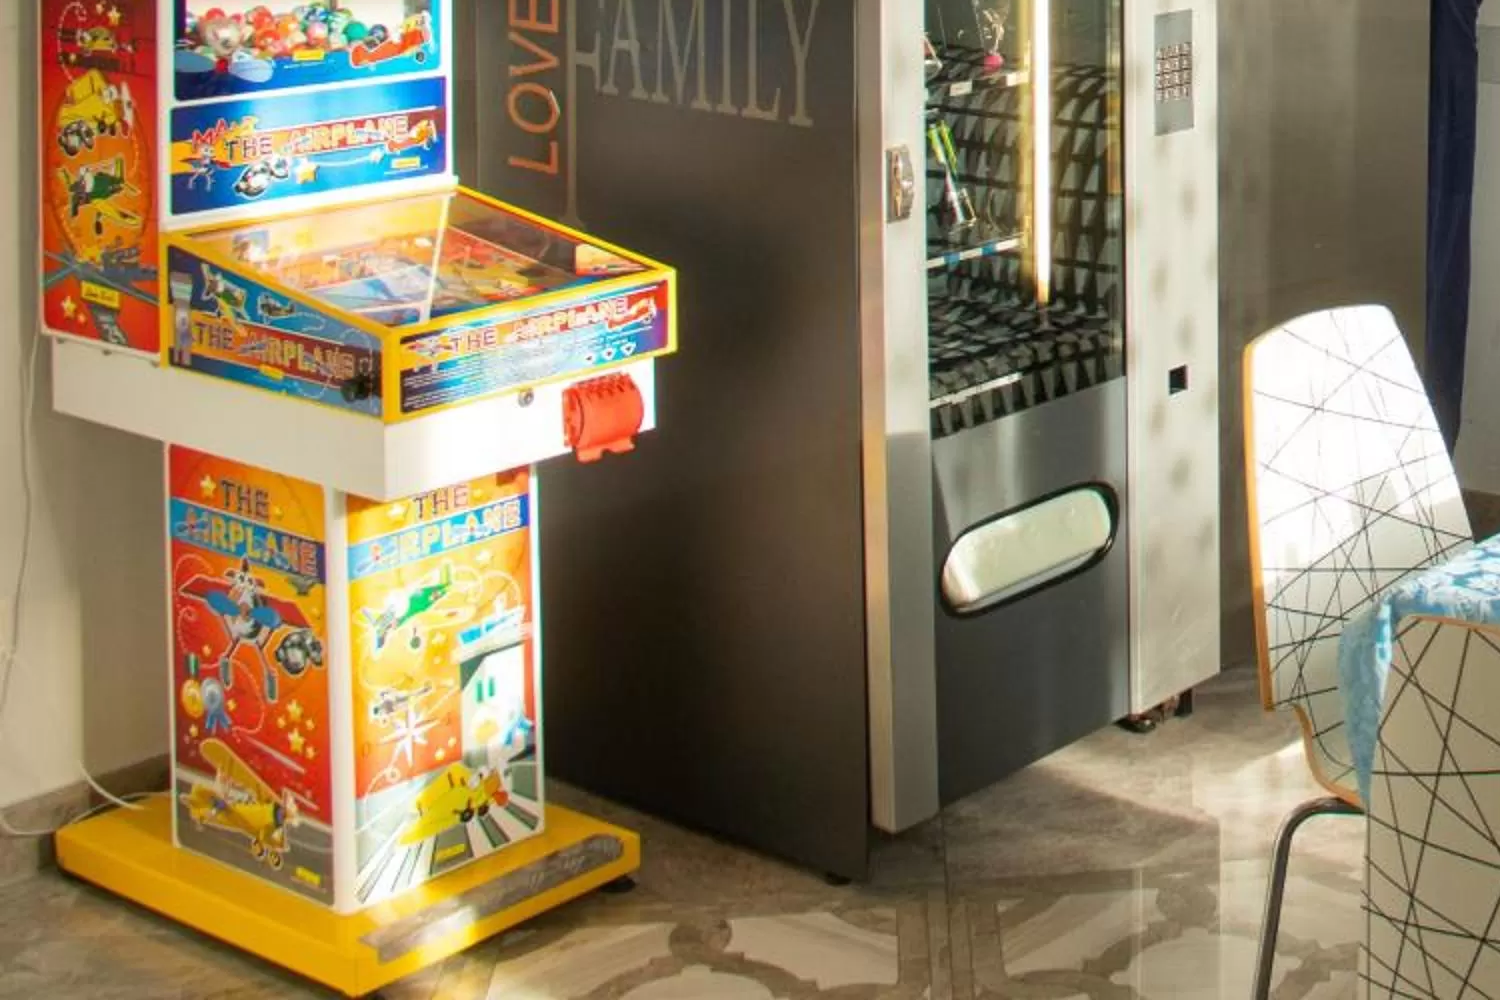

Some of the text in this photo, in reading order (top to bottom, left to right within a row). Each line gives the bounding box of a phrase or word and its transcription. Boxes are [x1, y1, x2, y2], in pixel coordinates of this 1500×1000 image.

[224, 115, 410, 160] THE AIRPLANE
[193, 322, 233, 350] THE
[243, 330, 356, 381] AIRPLANE
[449, 297, 629, 353] THE AIRPLANE
[220, 479, 270, 520] THE
[412, 484, 469, 519] THE
[180, 506, 317, 577] AIRPLANE
[364, 499, 521, 567] AIRPLANE
